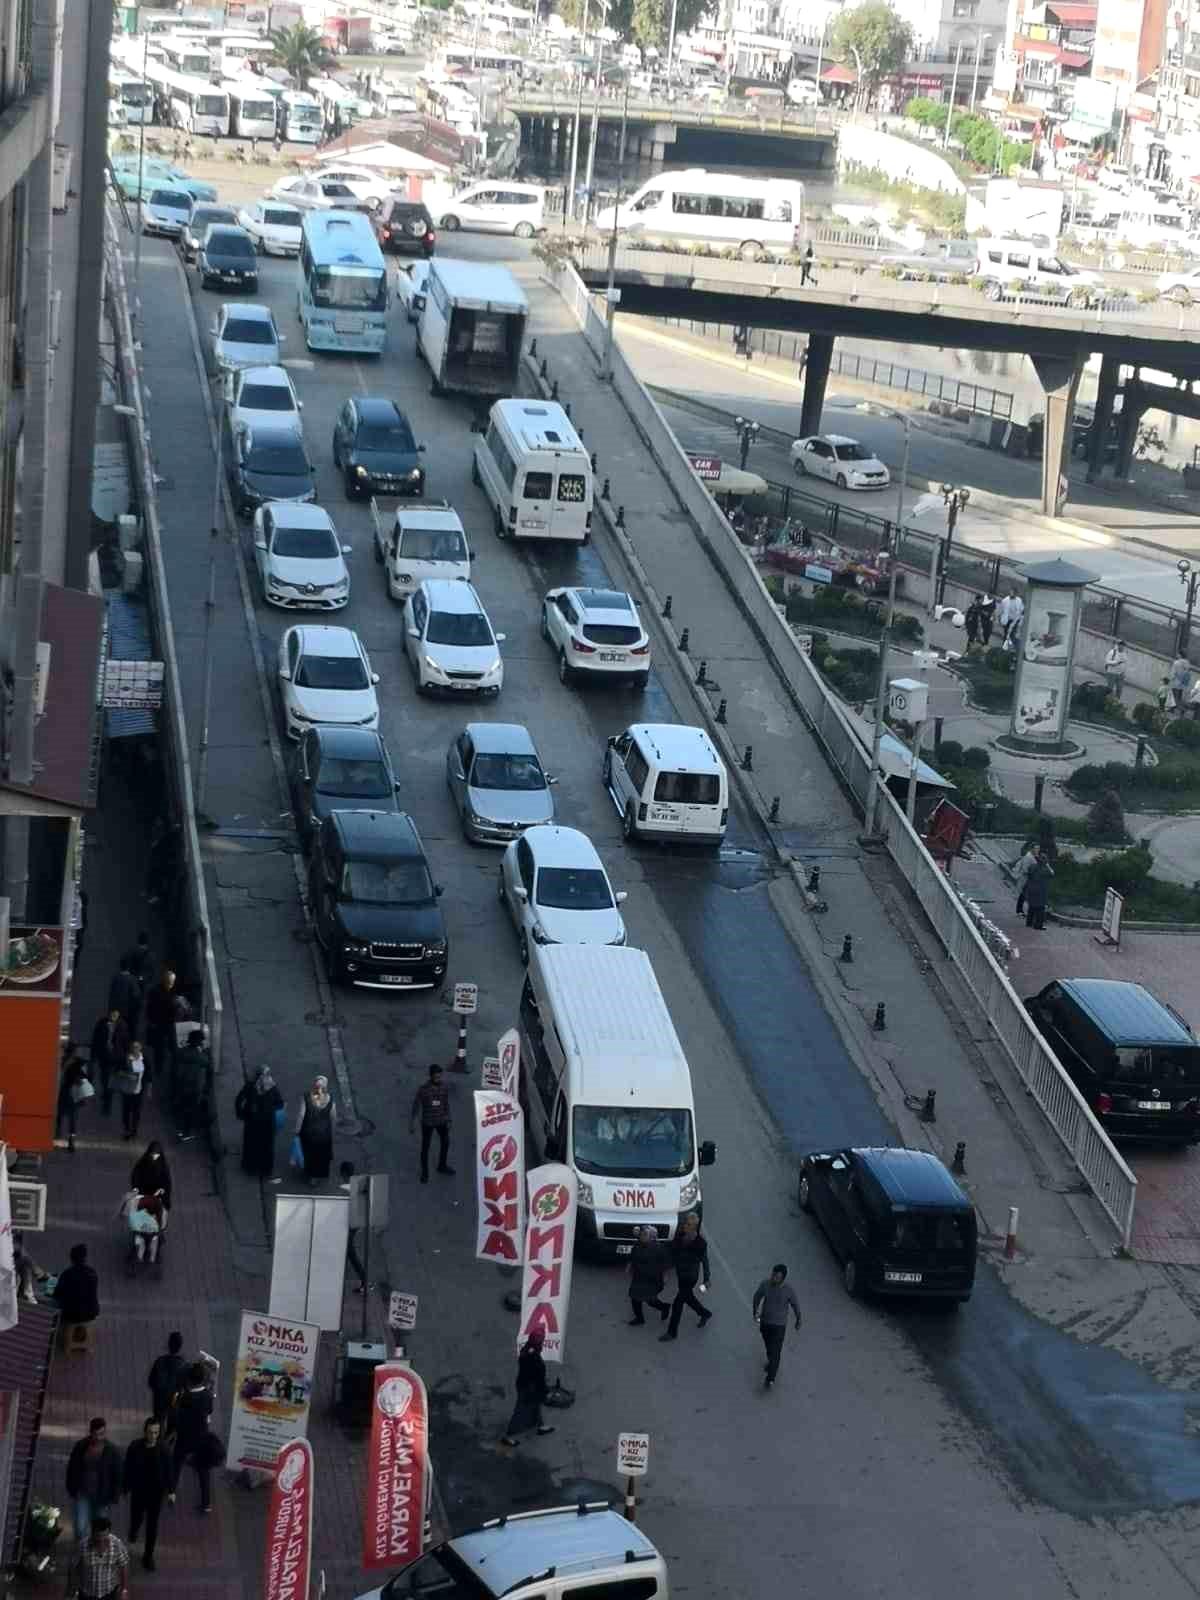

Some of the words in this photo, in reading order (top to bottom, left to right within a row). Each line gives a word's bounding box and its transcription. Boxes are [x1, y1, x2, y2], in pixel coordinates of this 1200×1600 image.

[613, 1189, 656, 1209] ONKA
[253, 1320, 305, 1344] ONKA
[270, 1340, 309, 1354] YURDU
